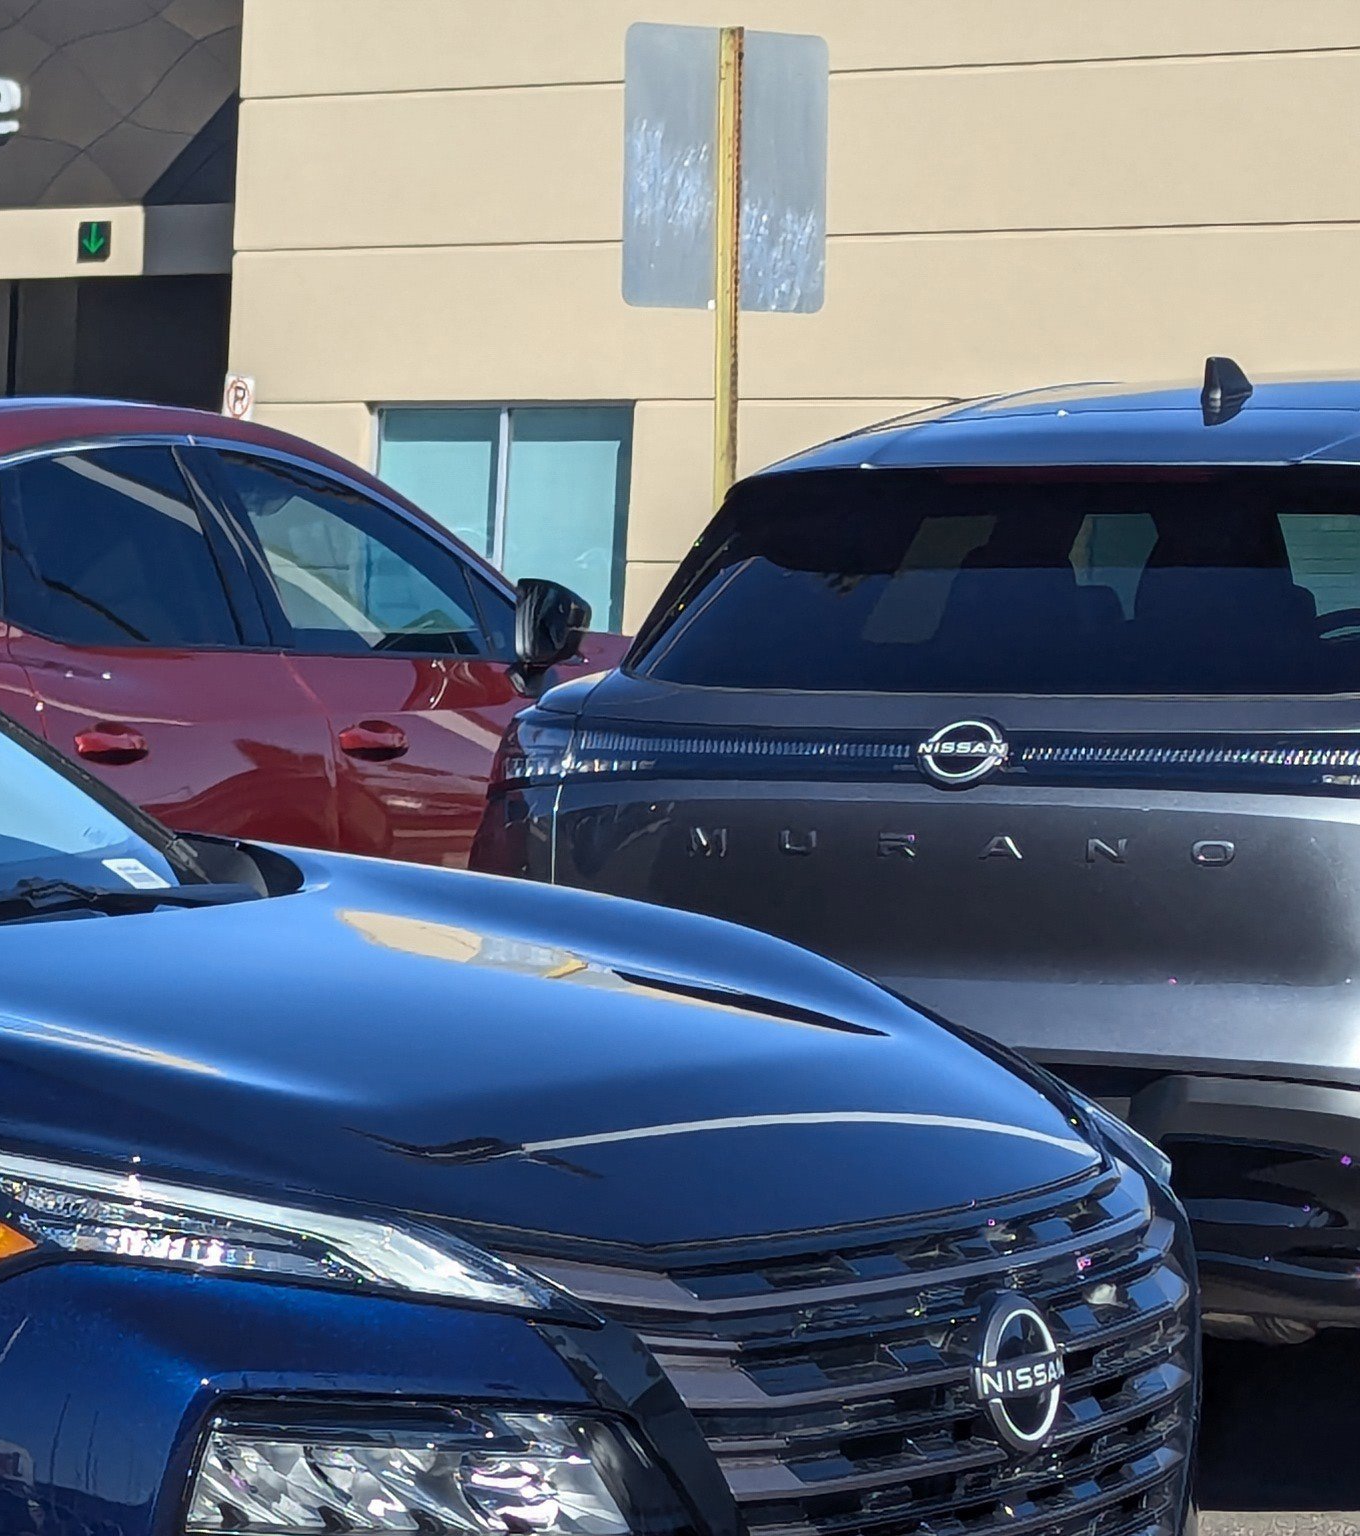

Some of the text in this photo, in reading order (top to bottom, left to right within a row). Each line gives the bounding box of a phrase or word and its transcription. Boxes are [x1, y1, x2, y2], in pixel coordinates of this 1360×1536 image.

[918, 742, 1008, 755] NISSAN
[688, 826, 1236, 867] MURANO
[982, 1355, 1065, 1396] NISSAN
